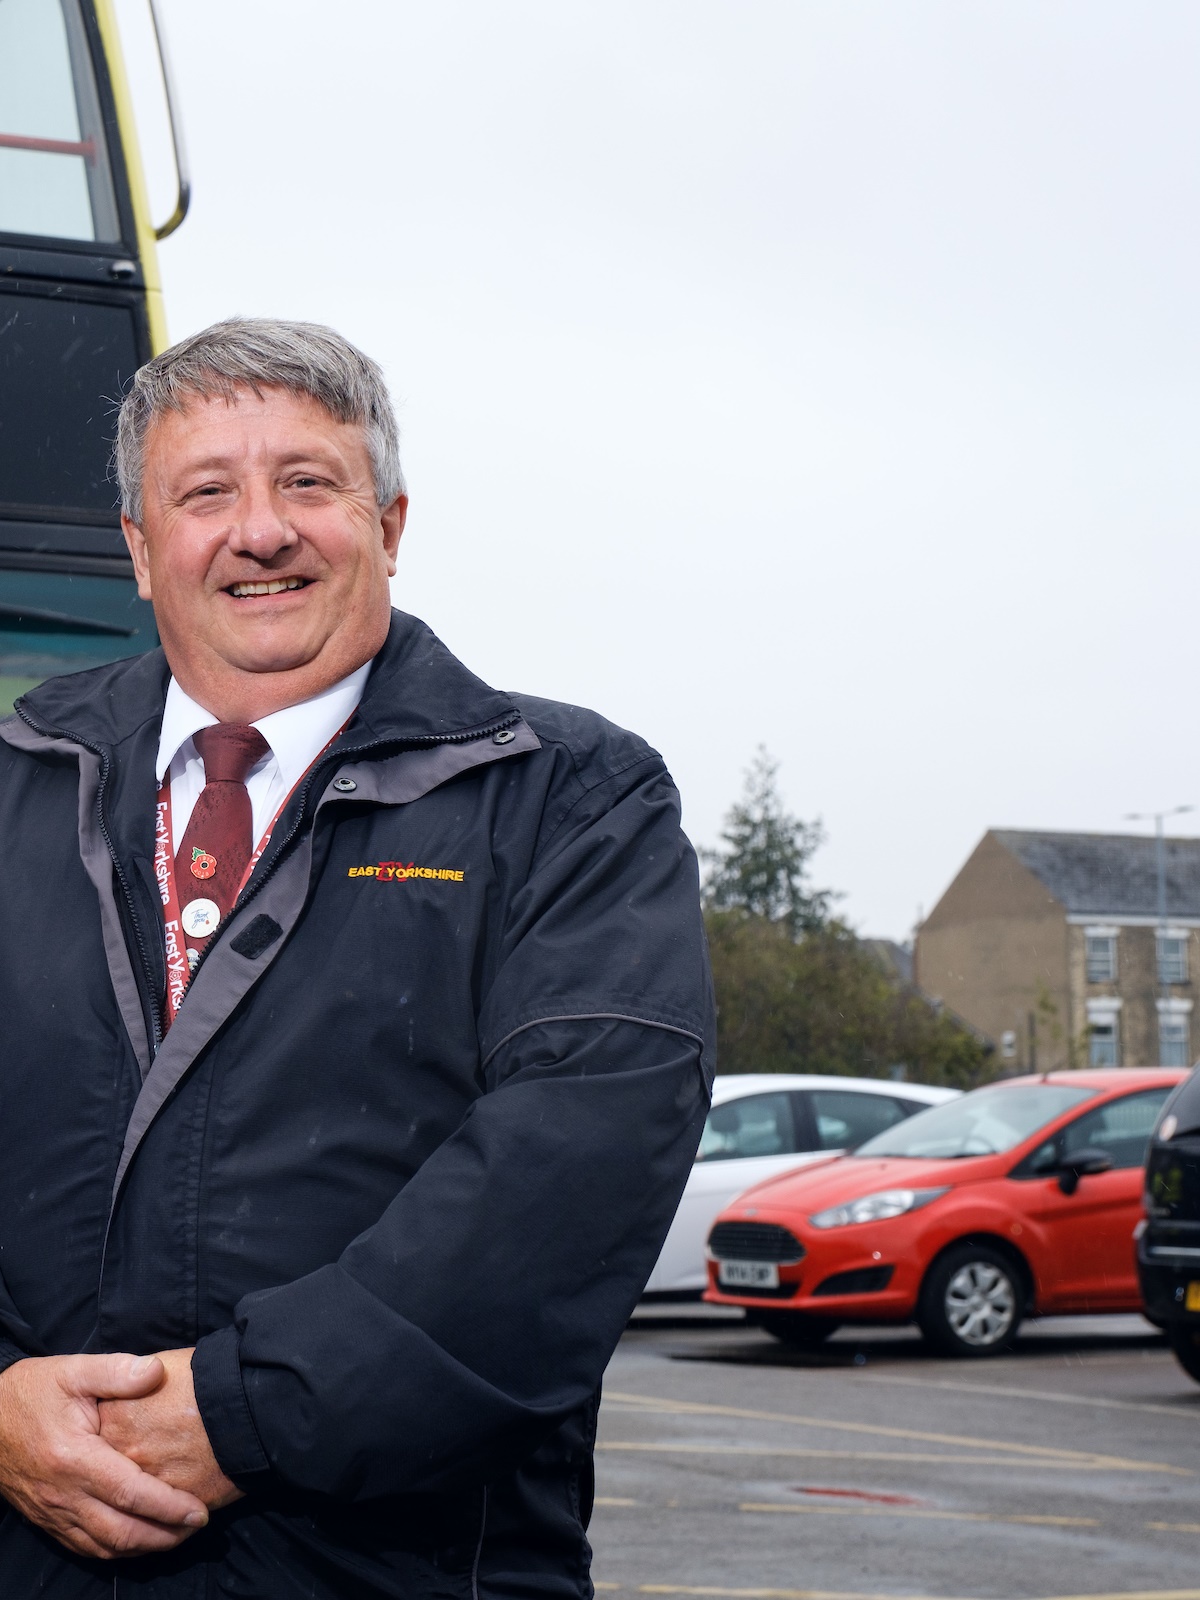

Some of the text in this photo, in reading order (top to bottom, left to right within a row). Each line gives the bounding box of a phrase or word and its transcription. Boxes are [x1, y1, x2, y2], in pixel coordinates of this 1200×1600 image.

[155, 801, 169, 833] East
[348, 866, 465, 882] EAST YORKSHIRE
[164, 919, 187, 1011] East Yorks
